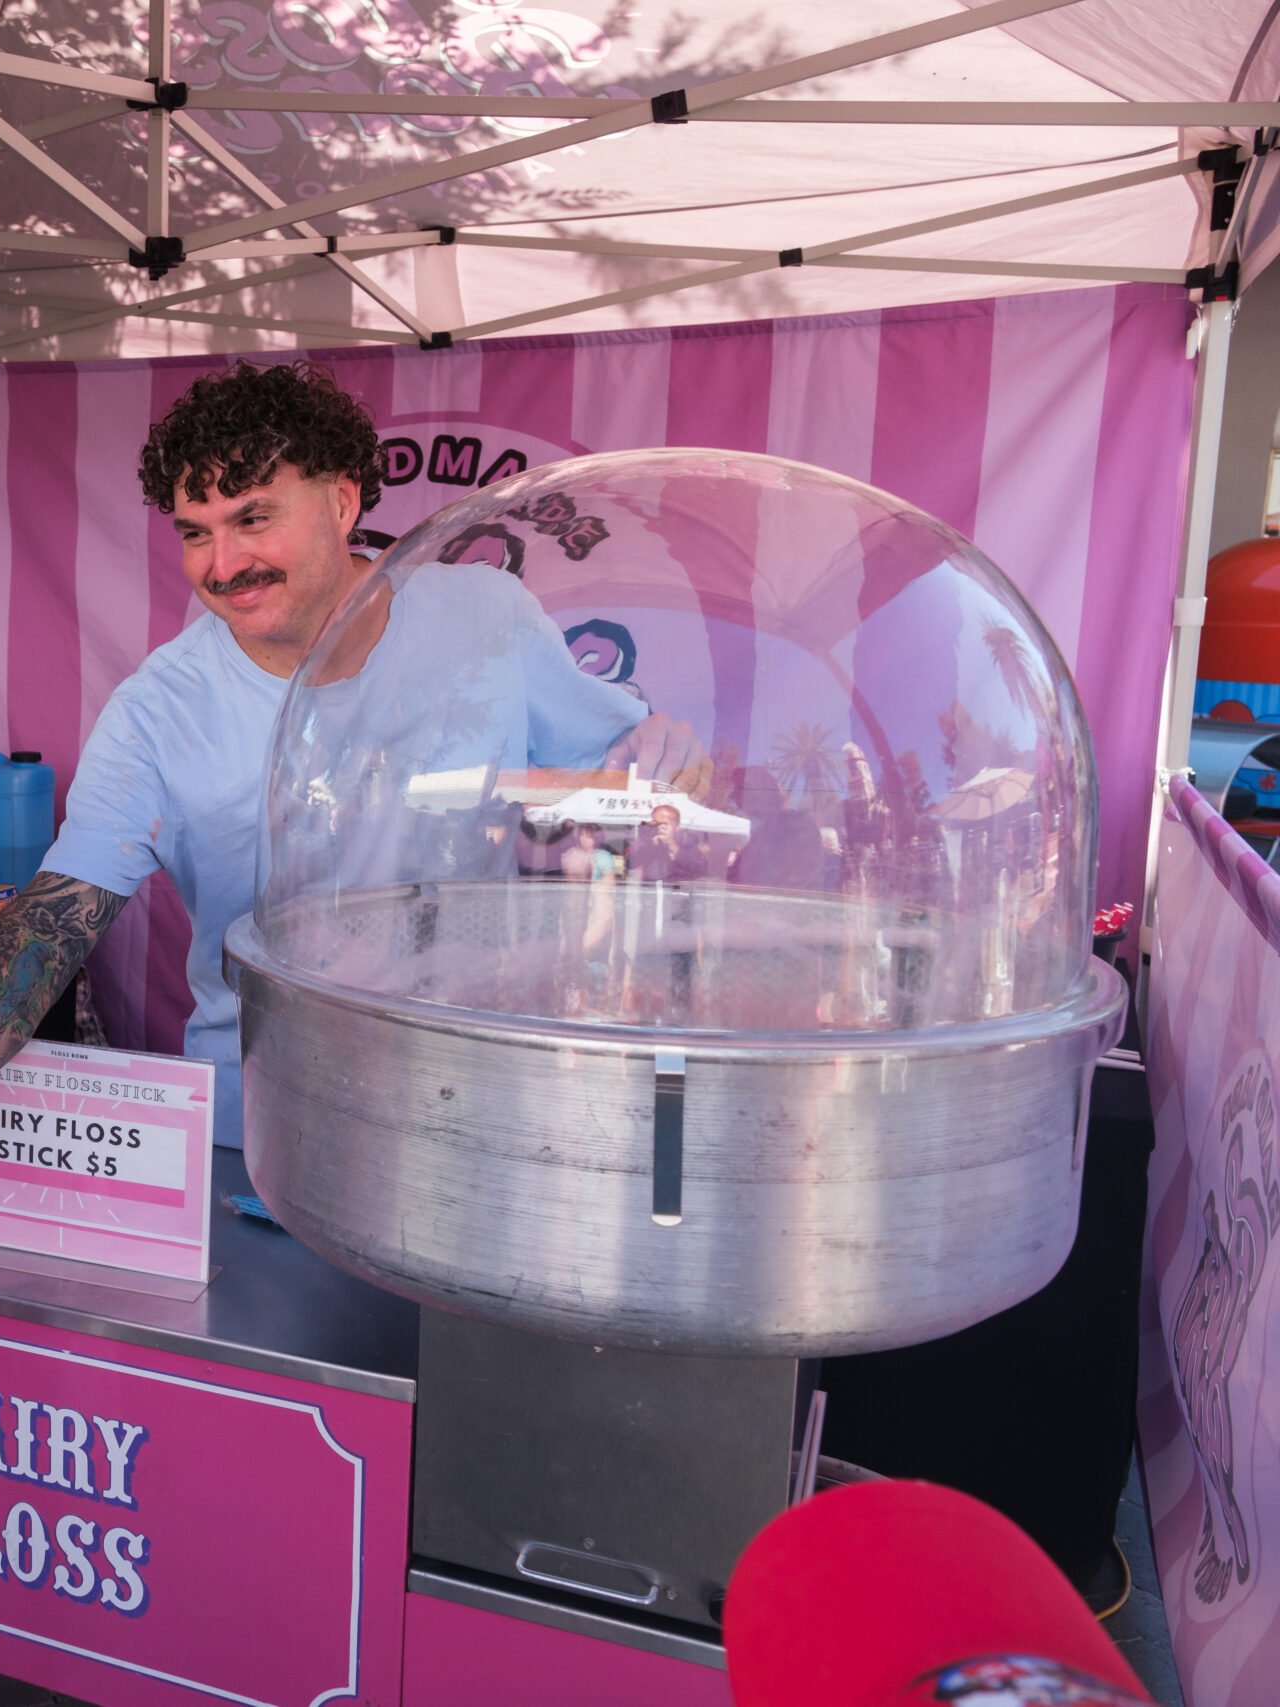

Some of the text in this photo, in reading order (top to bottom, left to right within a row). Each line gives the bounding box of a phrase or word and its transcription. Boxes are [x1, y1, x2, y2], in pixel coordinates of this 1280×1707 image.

[50, 1050, 70, 1058] FLOSS
[44, 1074, 103, 1093] FLOSS
[109, 1083, 166, 1102] STICK
[55, 1117, 142, 1149] FLOSS
[86, 1151, 118, 1176] $5
